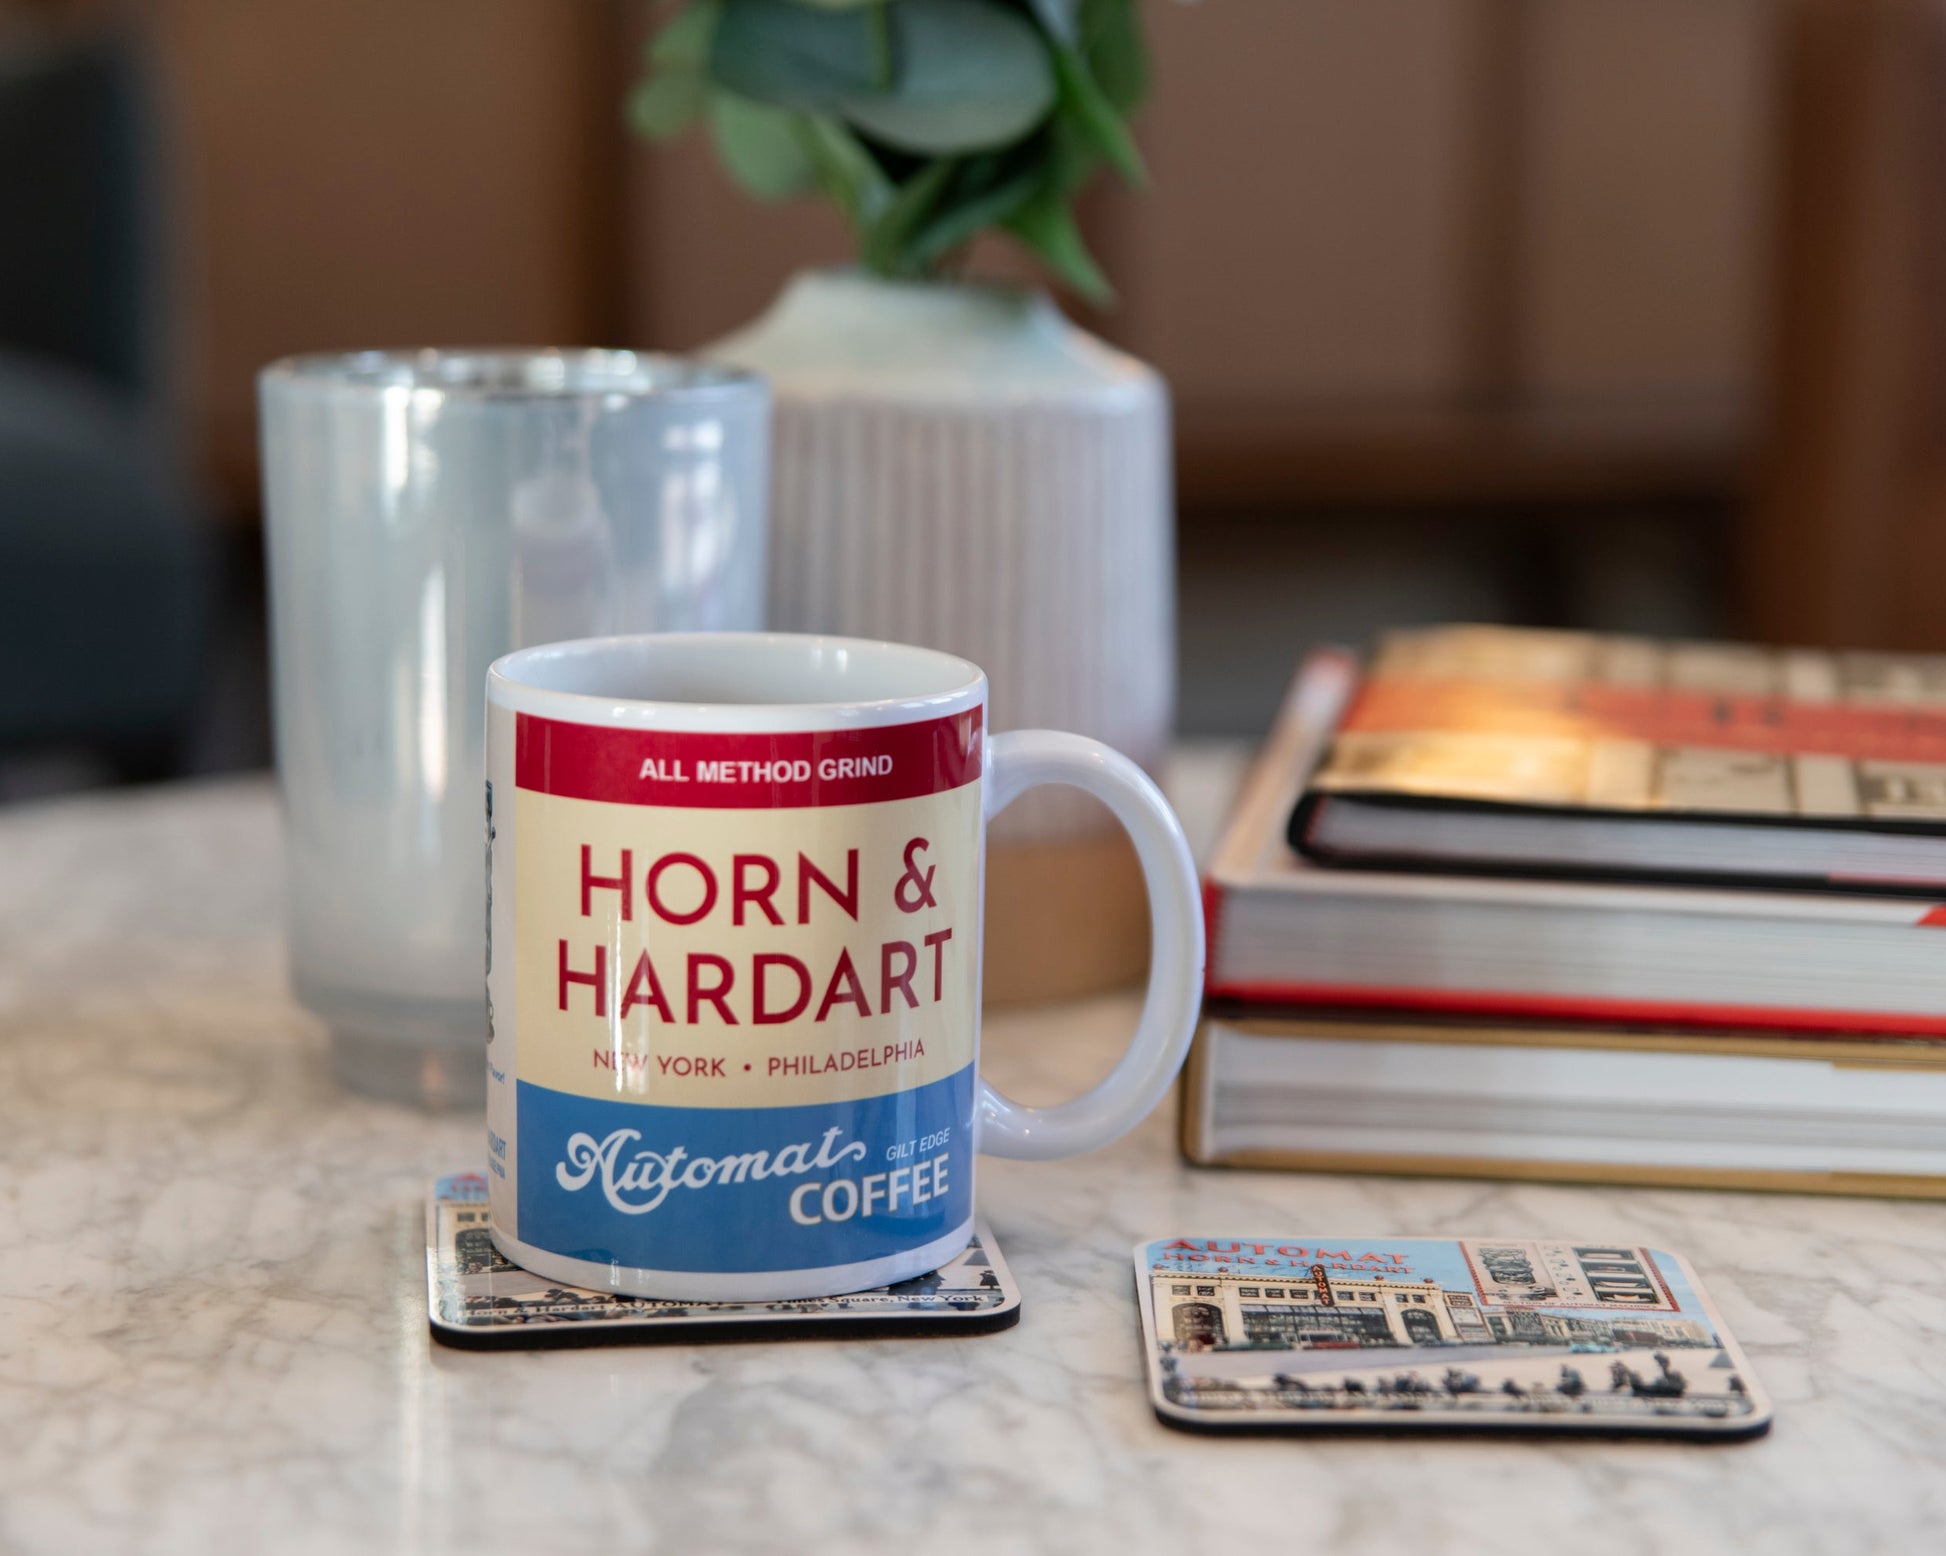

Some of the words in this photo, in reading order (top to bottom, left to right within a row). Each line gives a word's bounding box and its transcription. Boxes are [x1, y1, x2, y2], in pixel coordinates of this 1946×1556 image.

[639, 758, 690, 782] ALL
[696, 760, 812, 783] METHOD
[818, 755, 894, 781] GRIND
[580, 843, 860, 926] HORN
[893, 836, 938, 914] &
[558, 927, 953, 1025] HARDART
[656, 1055, 726, 1077] YORK
[767, 1038, 925, 1076] PHILADELPHIA
[885, 1142, 918, 1162] GILT
[919, 1127, 951, 1153] EDGE
[555, 1125, 867, 1216] Automat
[788, 1152, 950, 1226] COFFEE
[1163, 1253, 1255, 1265] HORN
[1164, 1239, 1408, 1265] AUTOMAT
[897, 1294, 936, 1302] New
[941, 1294, 984, 1302] York
